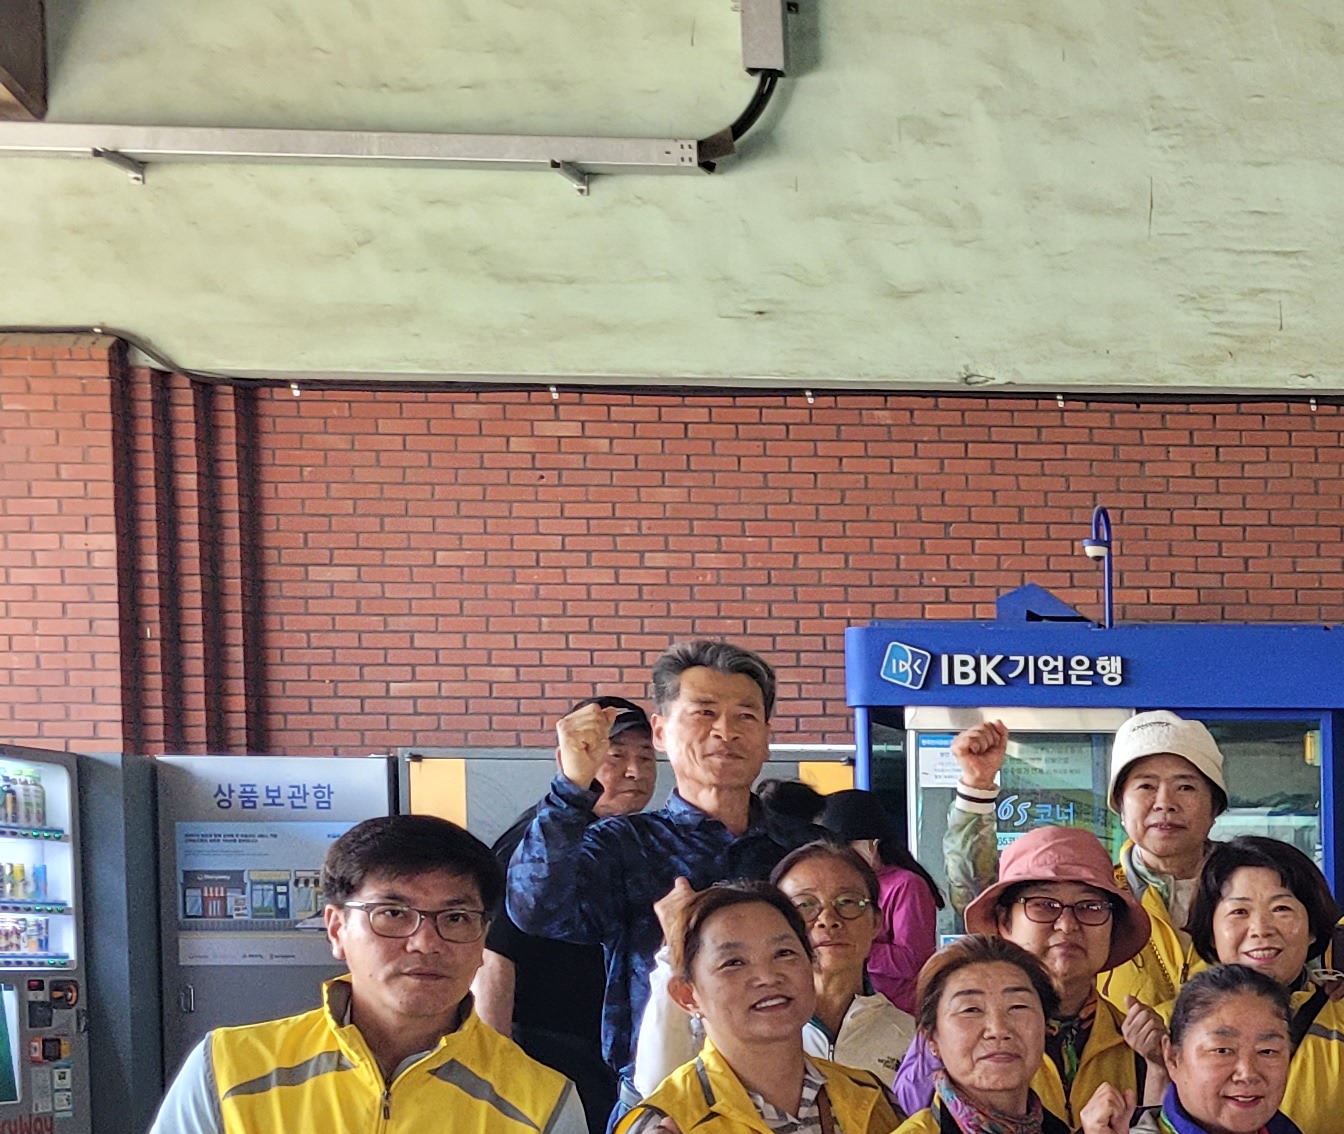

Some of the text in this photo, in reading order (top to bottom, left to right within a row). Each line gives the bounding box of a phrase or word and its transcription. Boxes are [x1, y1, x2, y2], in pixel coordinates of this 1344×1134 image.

[940, 653, 1123, 687] IBK기업은행
[213, 783, 335, 811] 상품보관함
[997, 794, 1075, 827] 65코너
